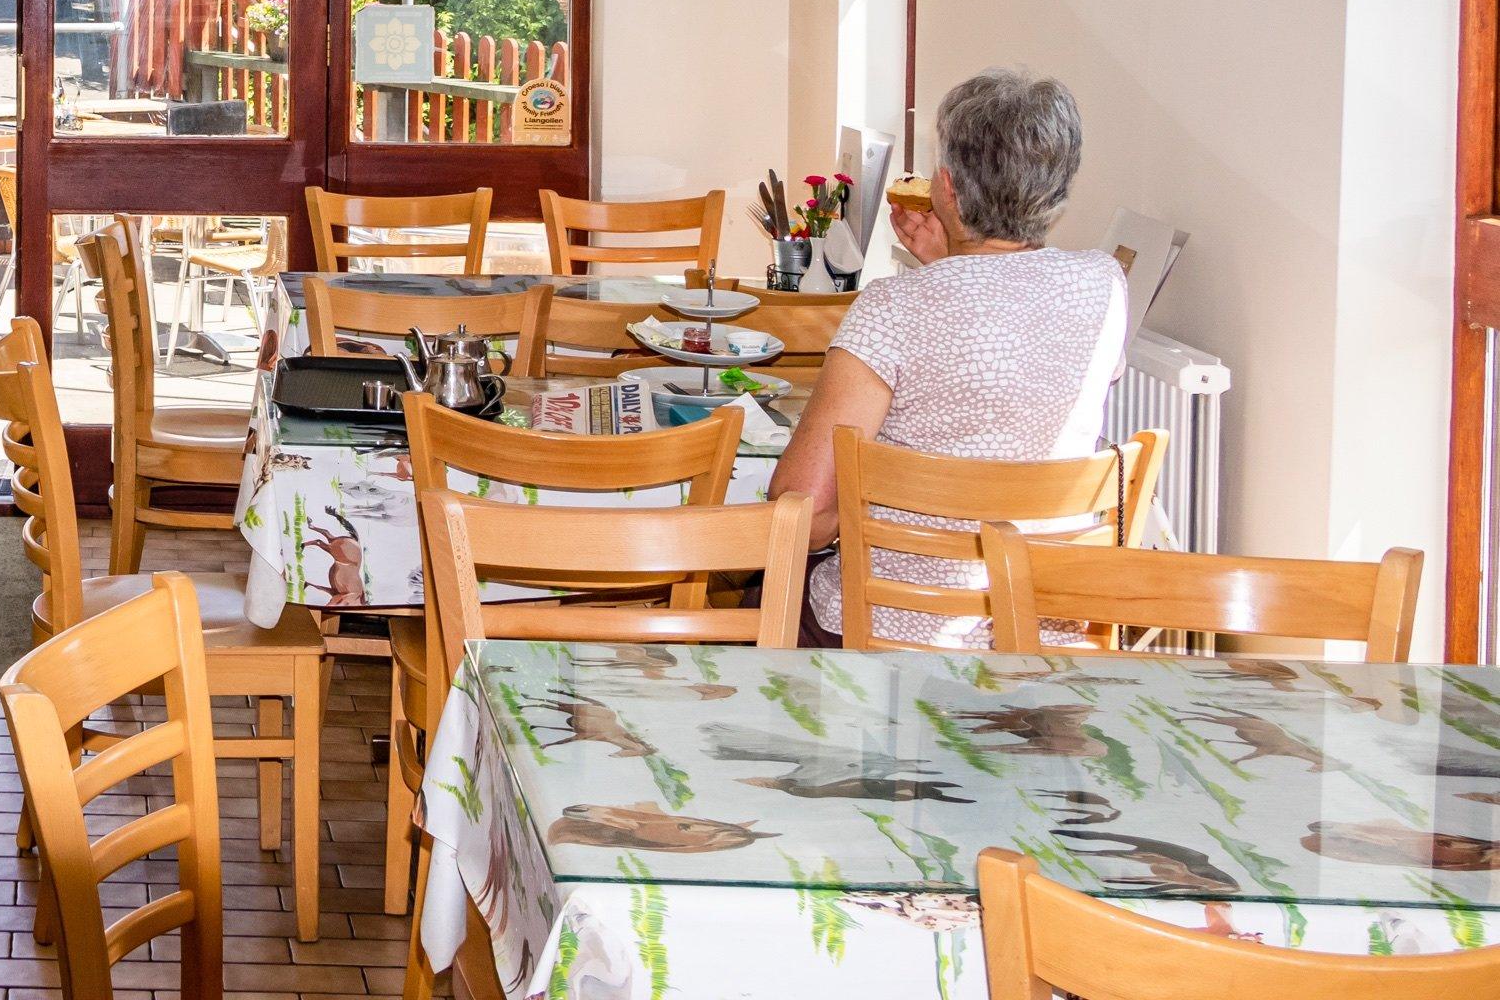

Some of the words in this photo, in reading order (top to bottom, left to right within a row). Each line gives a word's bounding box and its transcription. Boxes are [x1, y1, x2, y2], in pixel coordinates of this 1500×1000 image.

[521, 82, 544, 96] Croeso
[521, 101, 538, 117] Family
[540, 102, 564, 116] Friendly
[621, 384, 641, 413] DAILY
